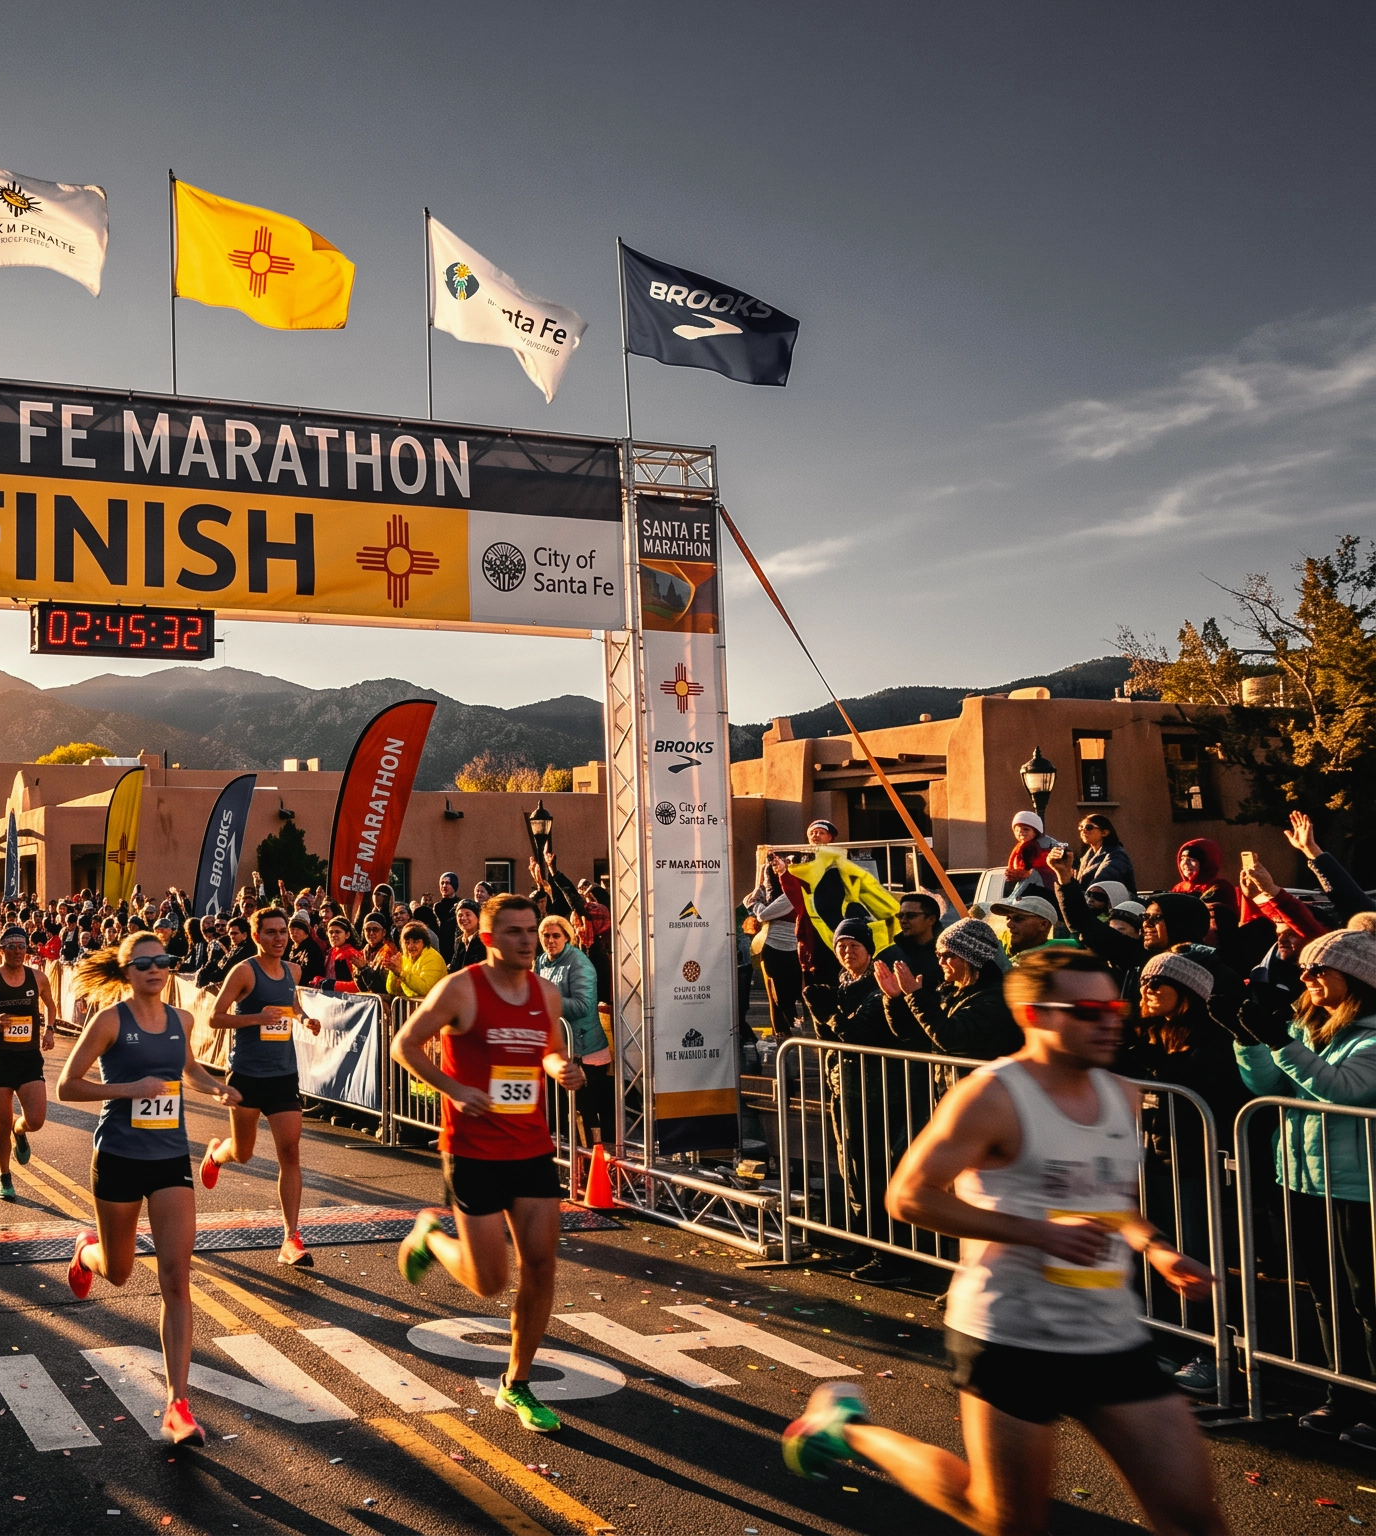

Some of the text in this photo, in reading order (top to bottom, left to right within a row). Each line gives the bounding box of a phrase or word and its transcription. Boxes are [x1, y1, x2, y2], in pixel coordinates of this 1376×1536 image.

[649, 281, 773, 319] BROOKS
[539, 318, 567, 345] Fe
[19, 400, 96, 468] FE
[123, 409, 471, 498] MARATHON
[643, 519, 711, 541] SANTA FE
[644, 538, 711, 557] MARATHON
[533, 547, 596, 574] City of
[533, 572, 614, 596] Santa Fe
[47, 611, 203, 650] 02:45:32
[654, 740, 714, 753] BROOKS
[357, 737, 405, 862] MARATHON
[679, 802, 708, 814] City of
[679, 814, 718, 825] Santa Fe
[210, 809, 233, 888] BROOKS
[655, 859, 721, 869] SF MARATHON
[140, 1099, 174, 1116] 214
